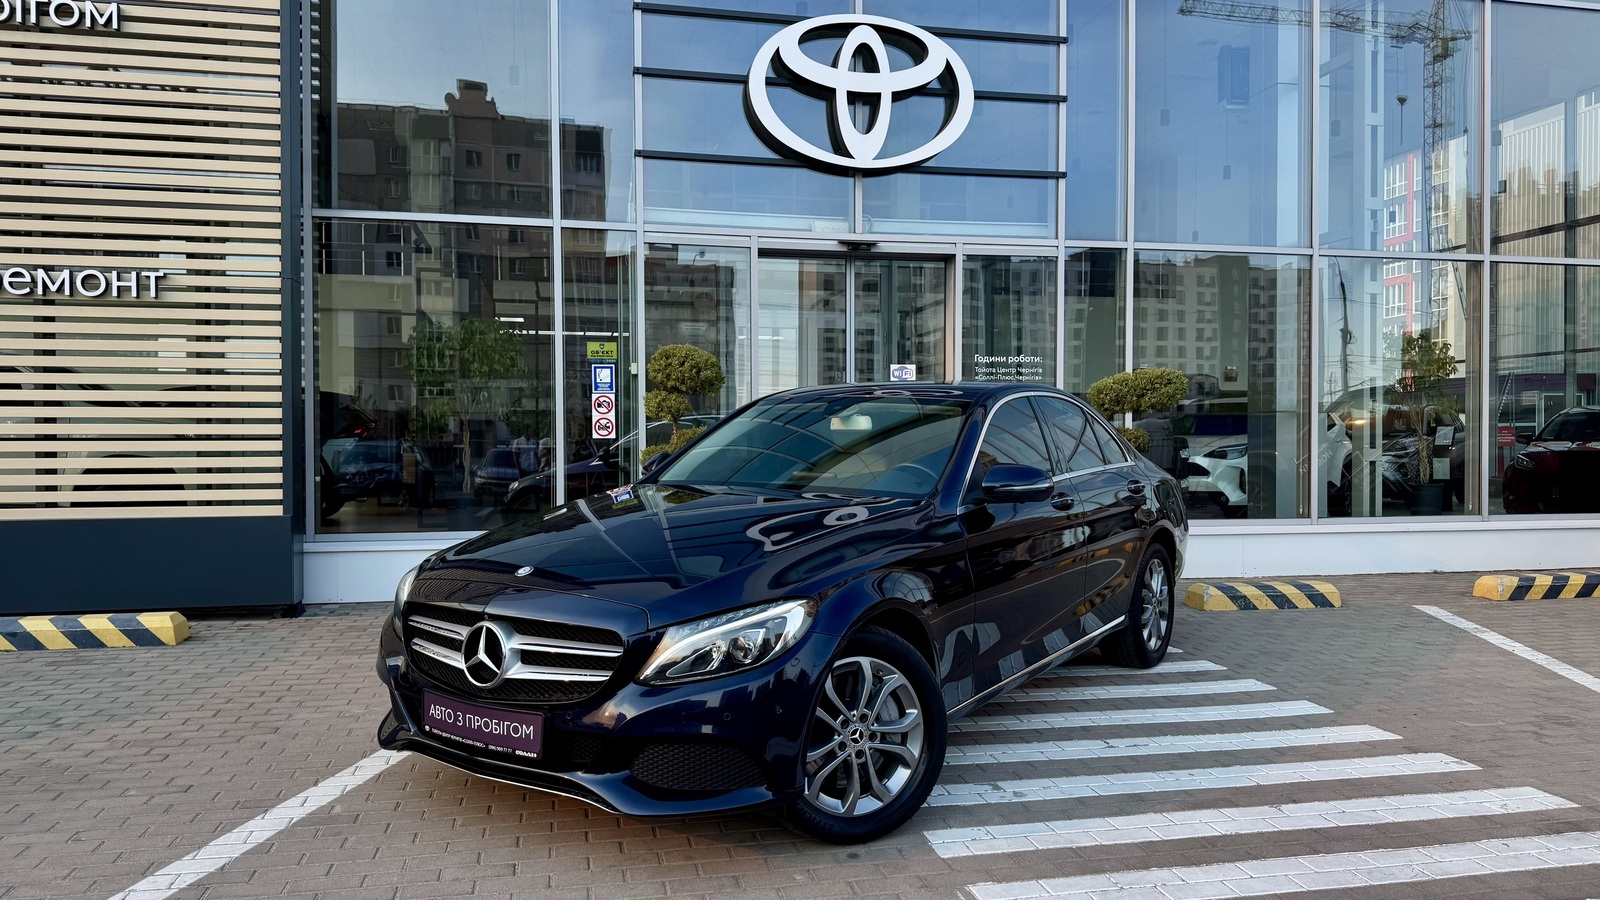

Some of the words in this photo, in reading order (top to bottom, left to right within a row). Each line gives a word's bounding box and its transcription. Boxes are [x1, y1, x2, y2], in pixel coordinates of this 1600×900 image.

[0, 267, 164, 298] емонт
[974, 354, 1006, 364] Години
[1008, 353, 1043, 364] роботи:
[1017, 366, 1043, 374] Чернігів
[429, 704, 454, 723] АВТО
[466, 714, 534, 740] ПРОБІГОМ
